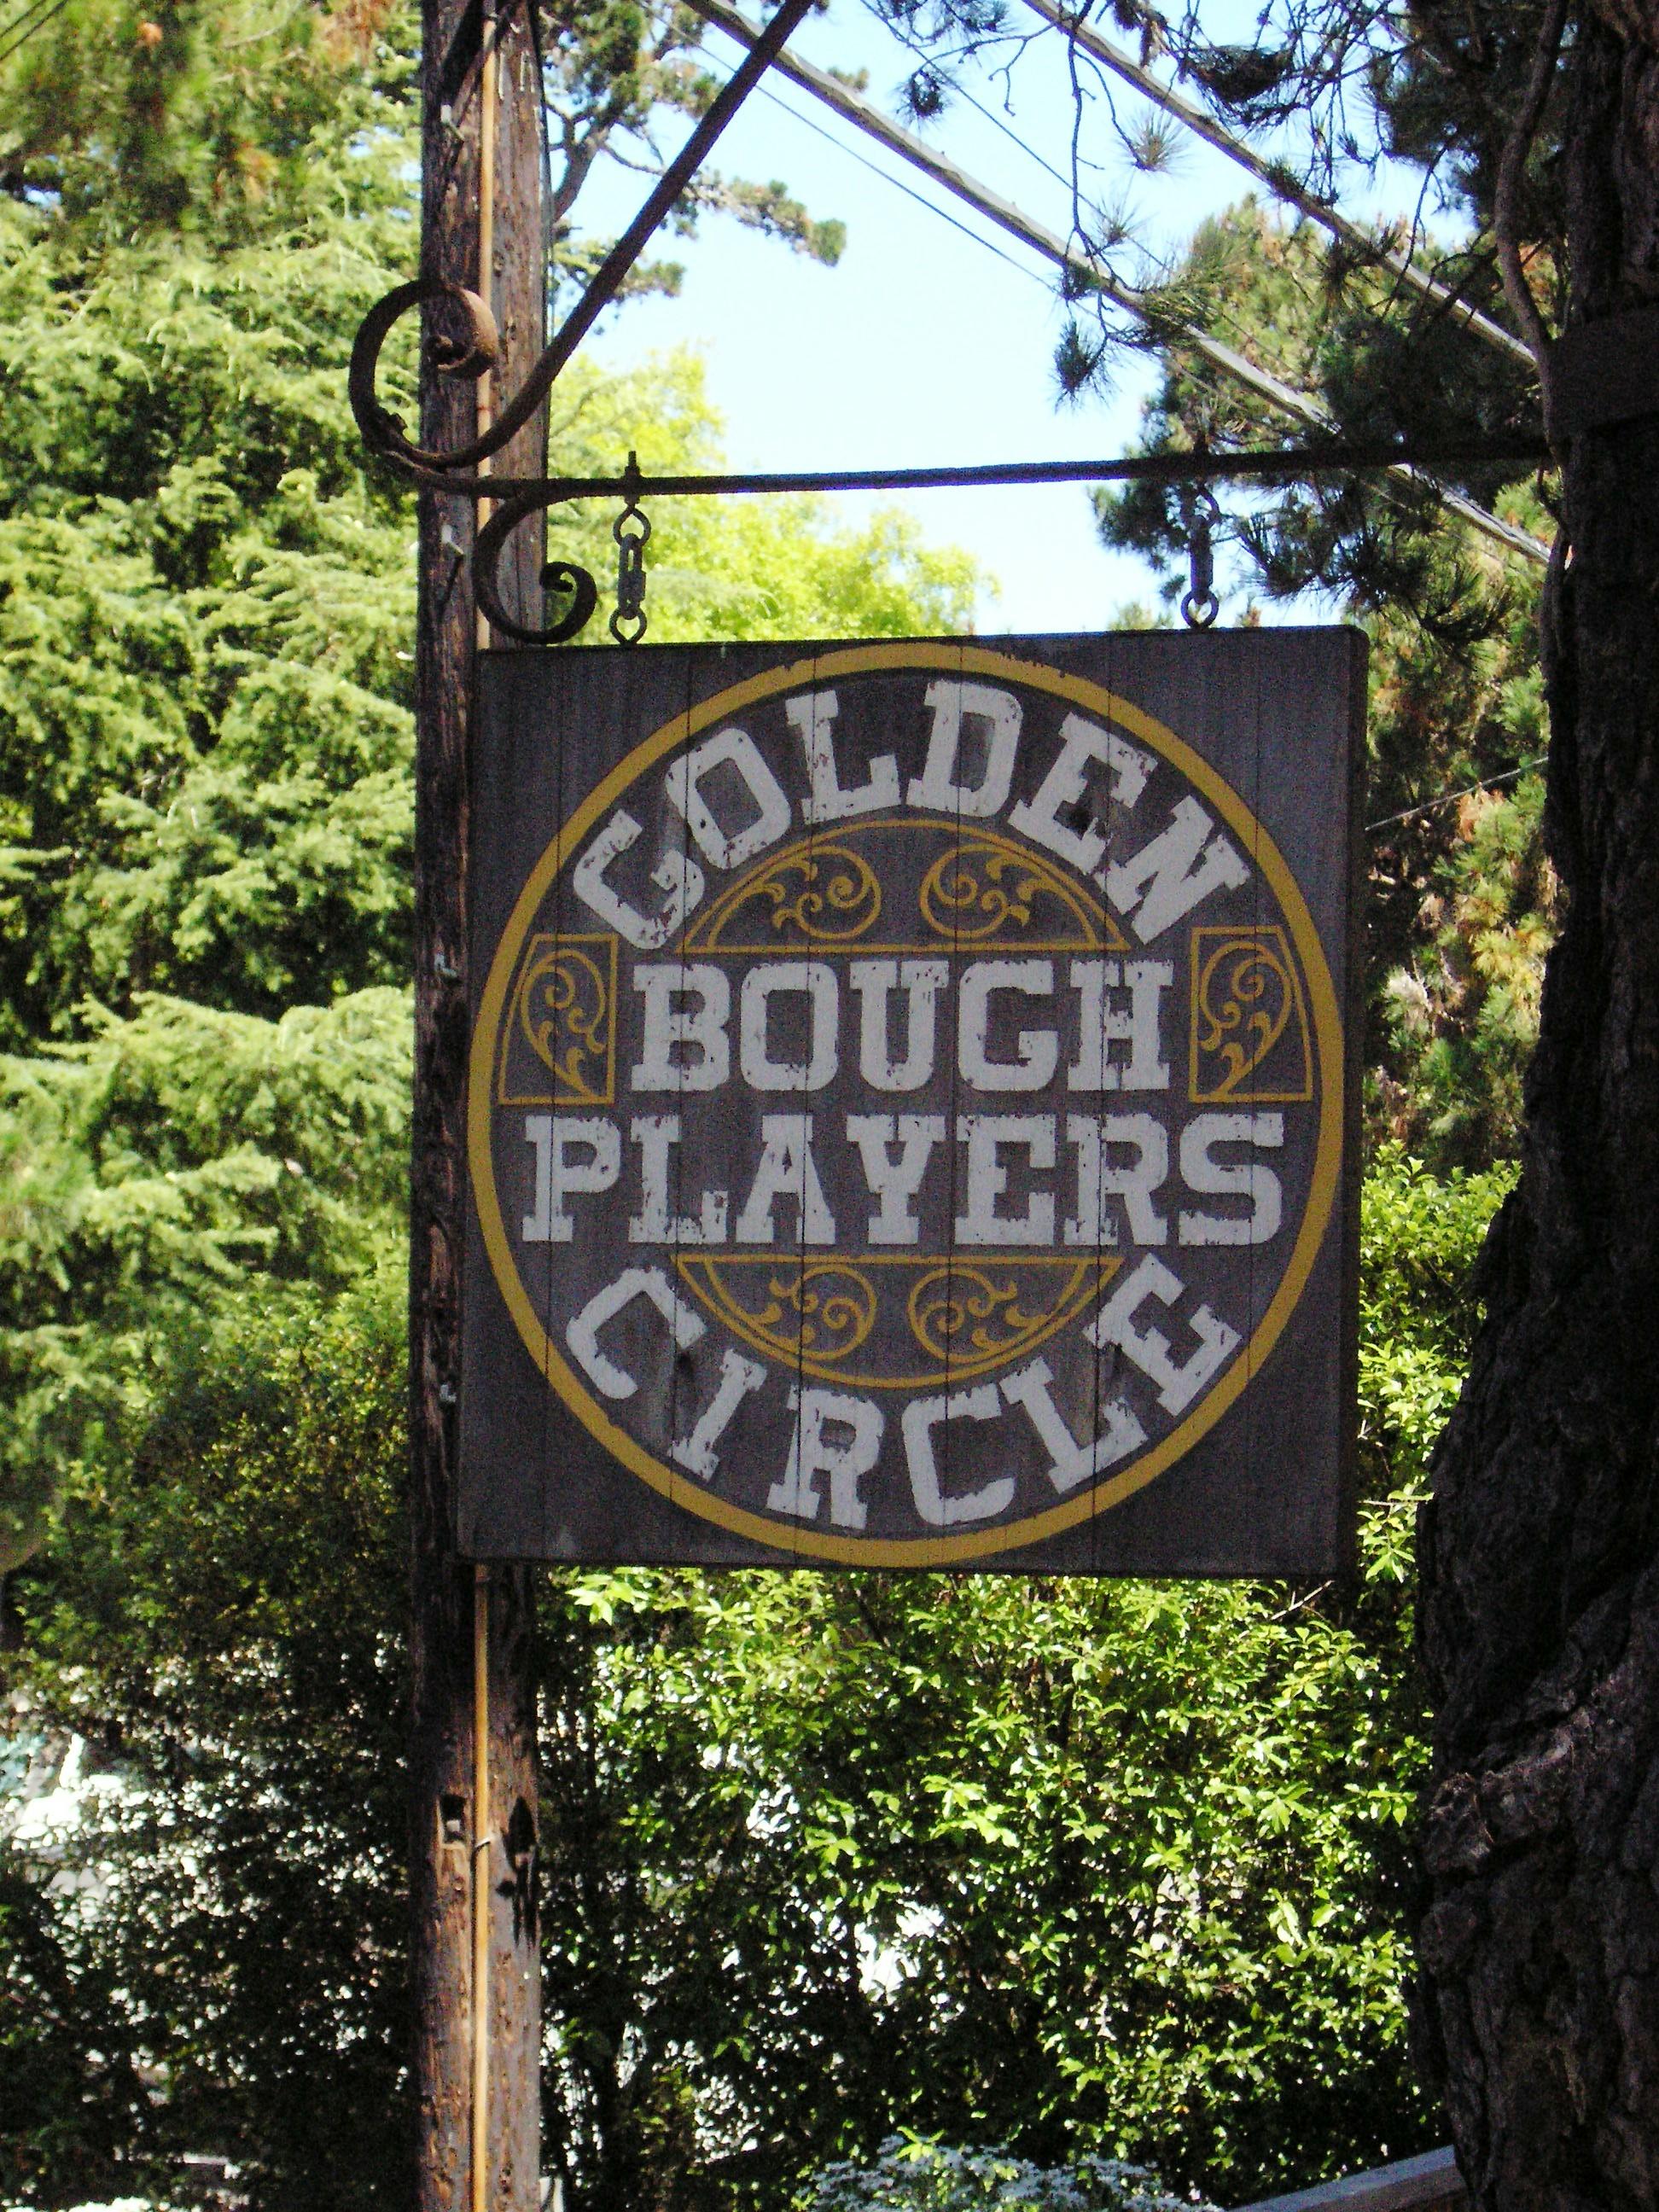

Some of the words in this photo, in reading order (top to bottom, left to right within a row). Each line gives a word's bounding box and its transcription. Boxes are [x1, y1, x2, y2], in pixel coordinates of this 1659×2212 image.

[573, 680, 1250, 949] GOLDEN
[631, 960, 1174, 1092] BOUGH
[521, 1112, 1284, 1247] PLAYERS
[566, 1253, 1242, 1529] CIRCLE
